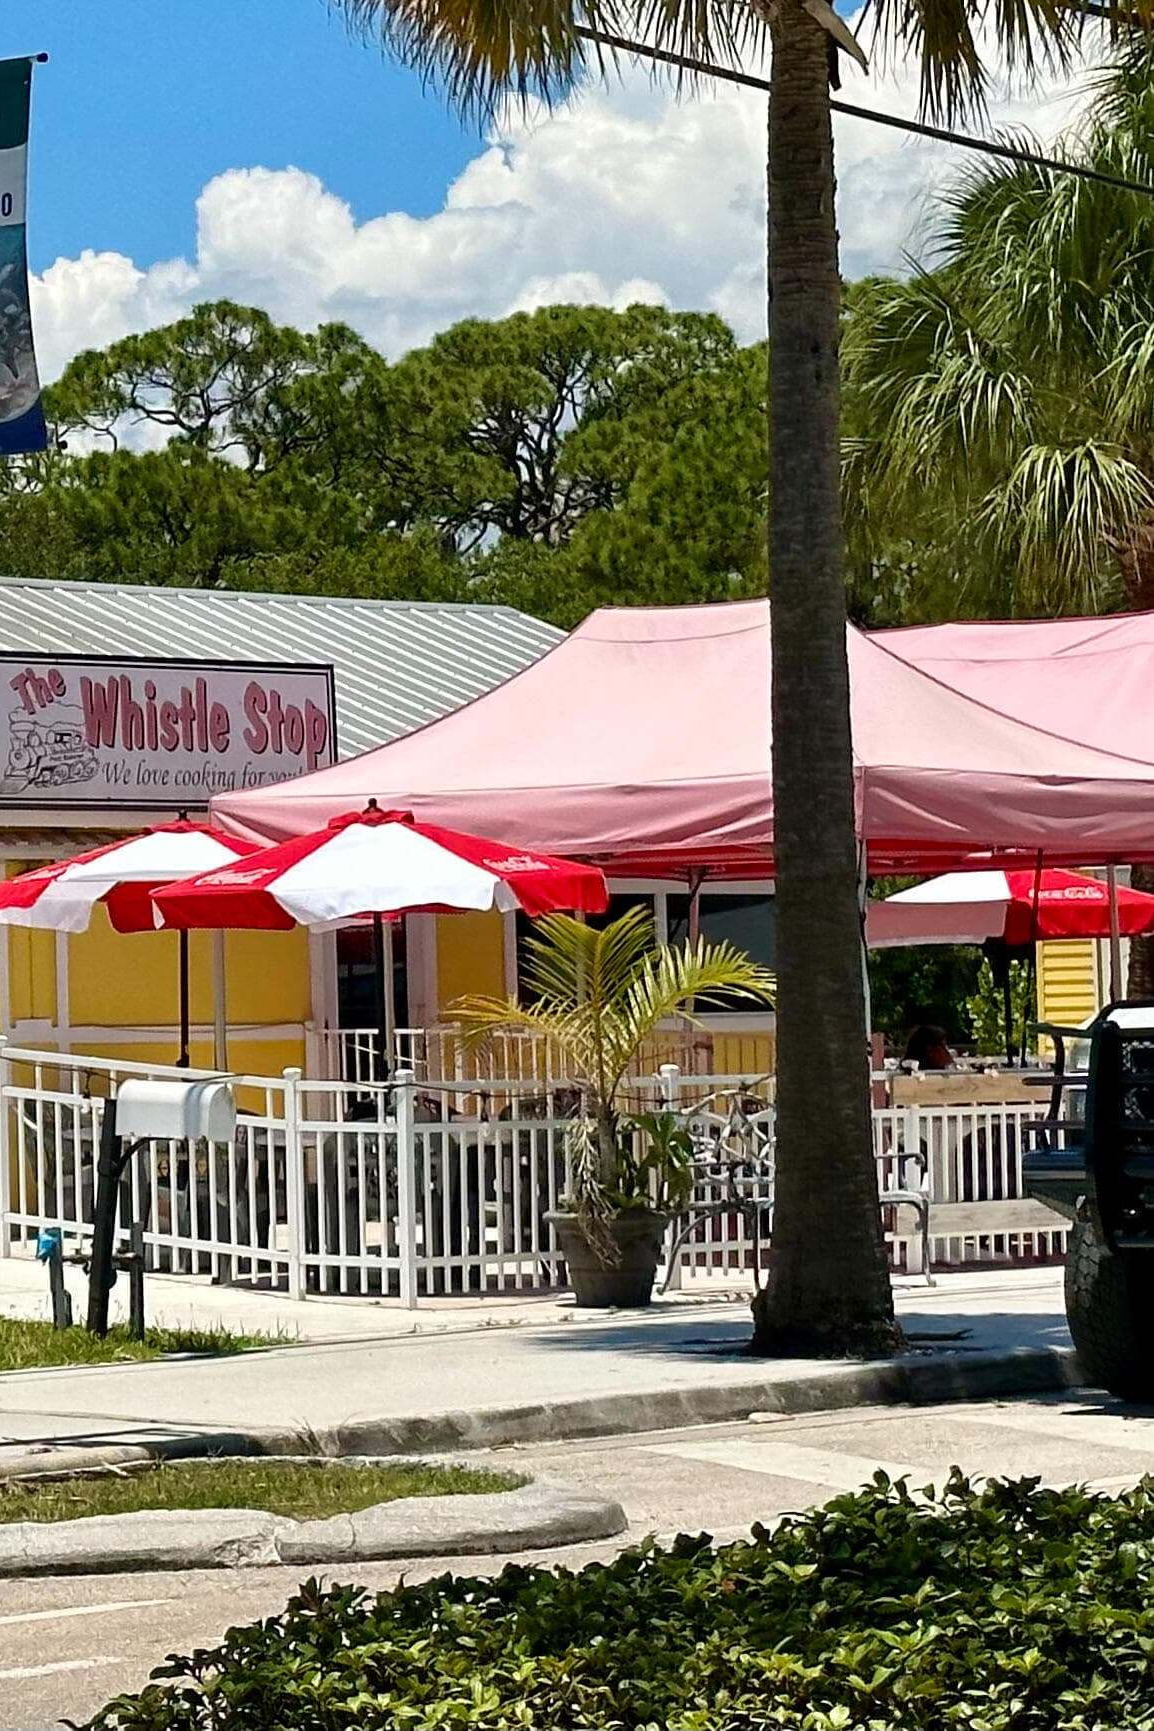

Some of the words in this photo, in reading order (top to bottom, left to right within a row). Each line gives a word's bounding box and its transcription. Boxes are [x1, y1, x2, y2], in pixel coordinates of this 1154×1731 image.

[9, 667, 66, 715] The
[80, 673, 231, 754] Whistle
[243, 680, 328, 770] Stop
[102, 759, 132, 786] We
[136, 759, 170, 786] love
[174, 760, 236, 793] cooking
[241, 761, 266, 790] for
